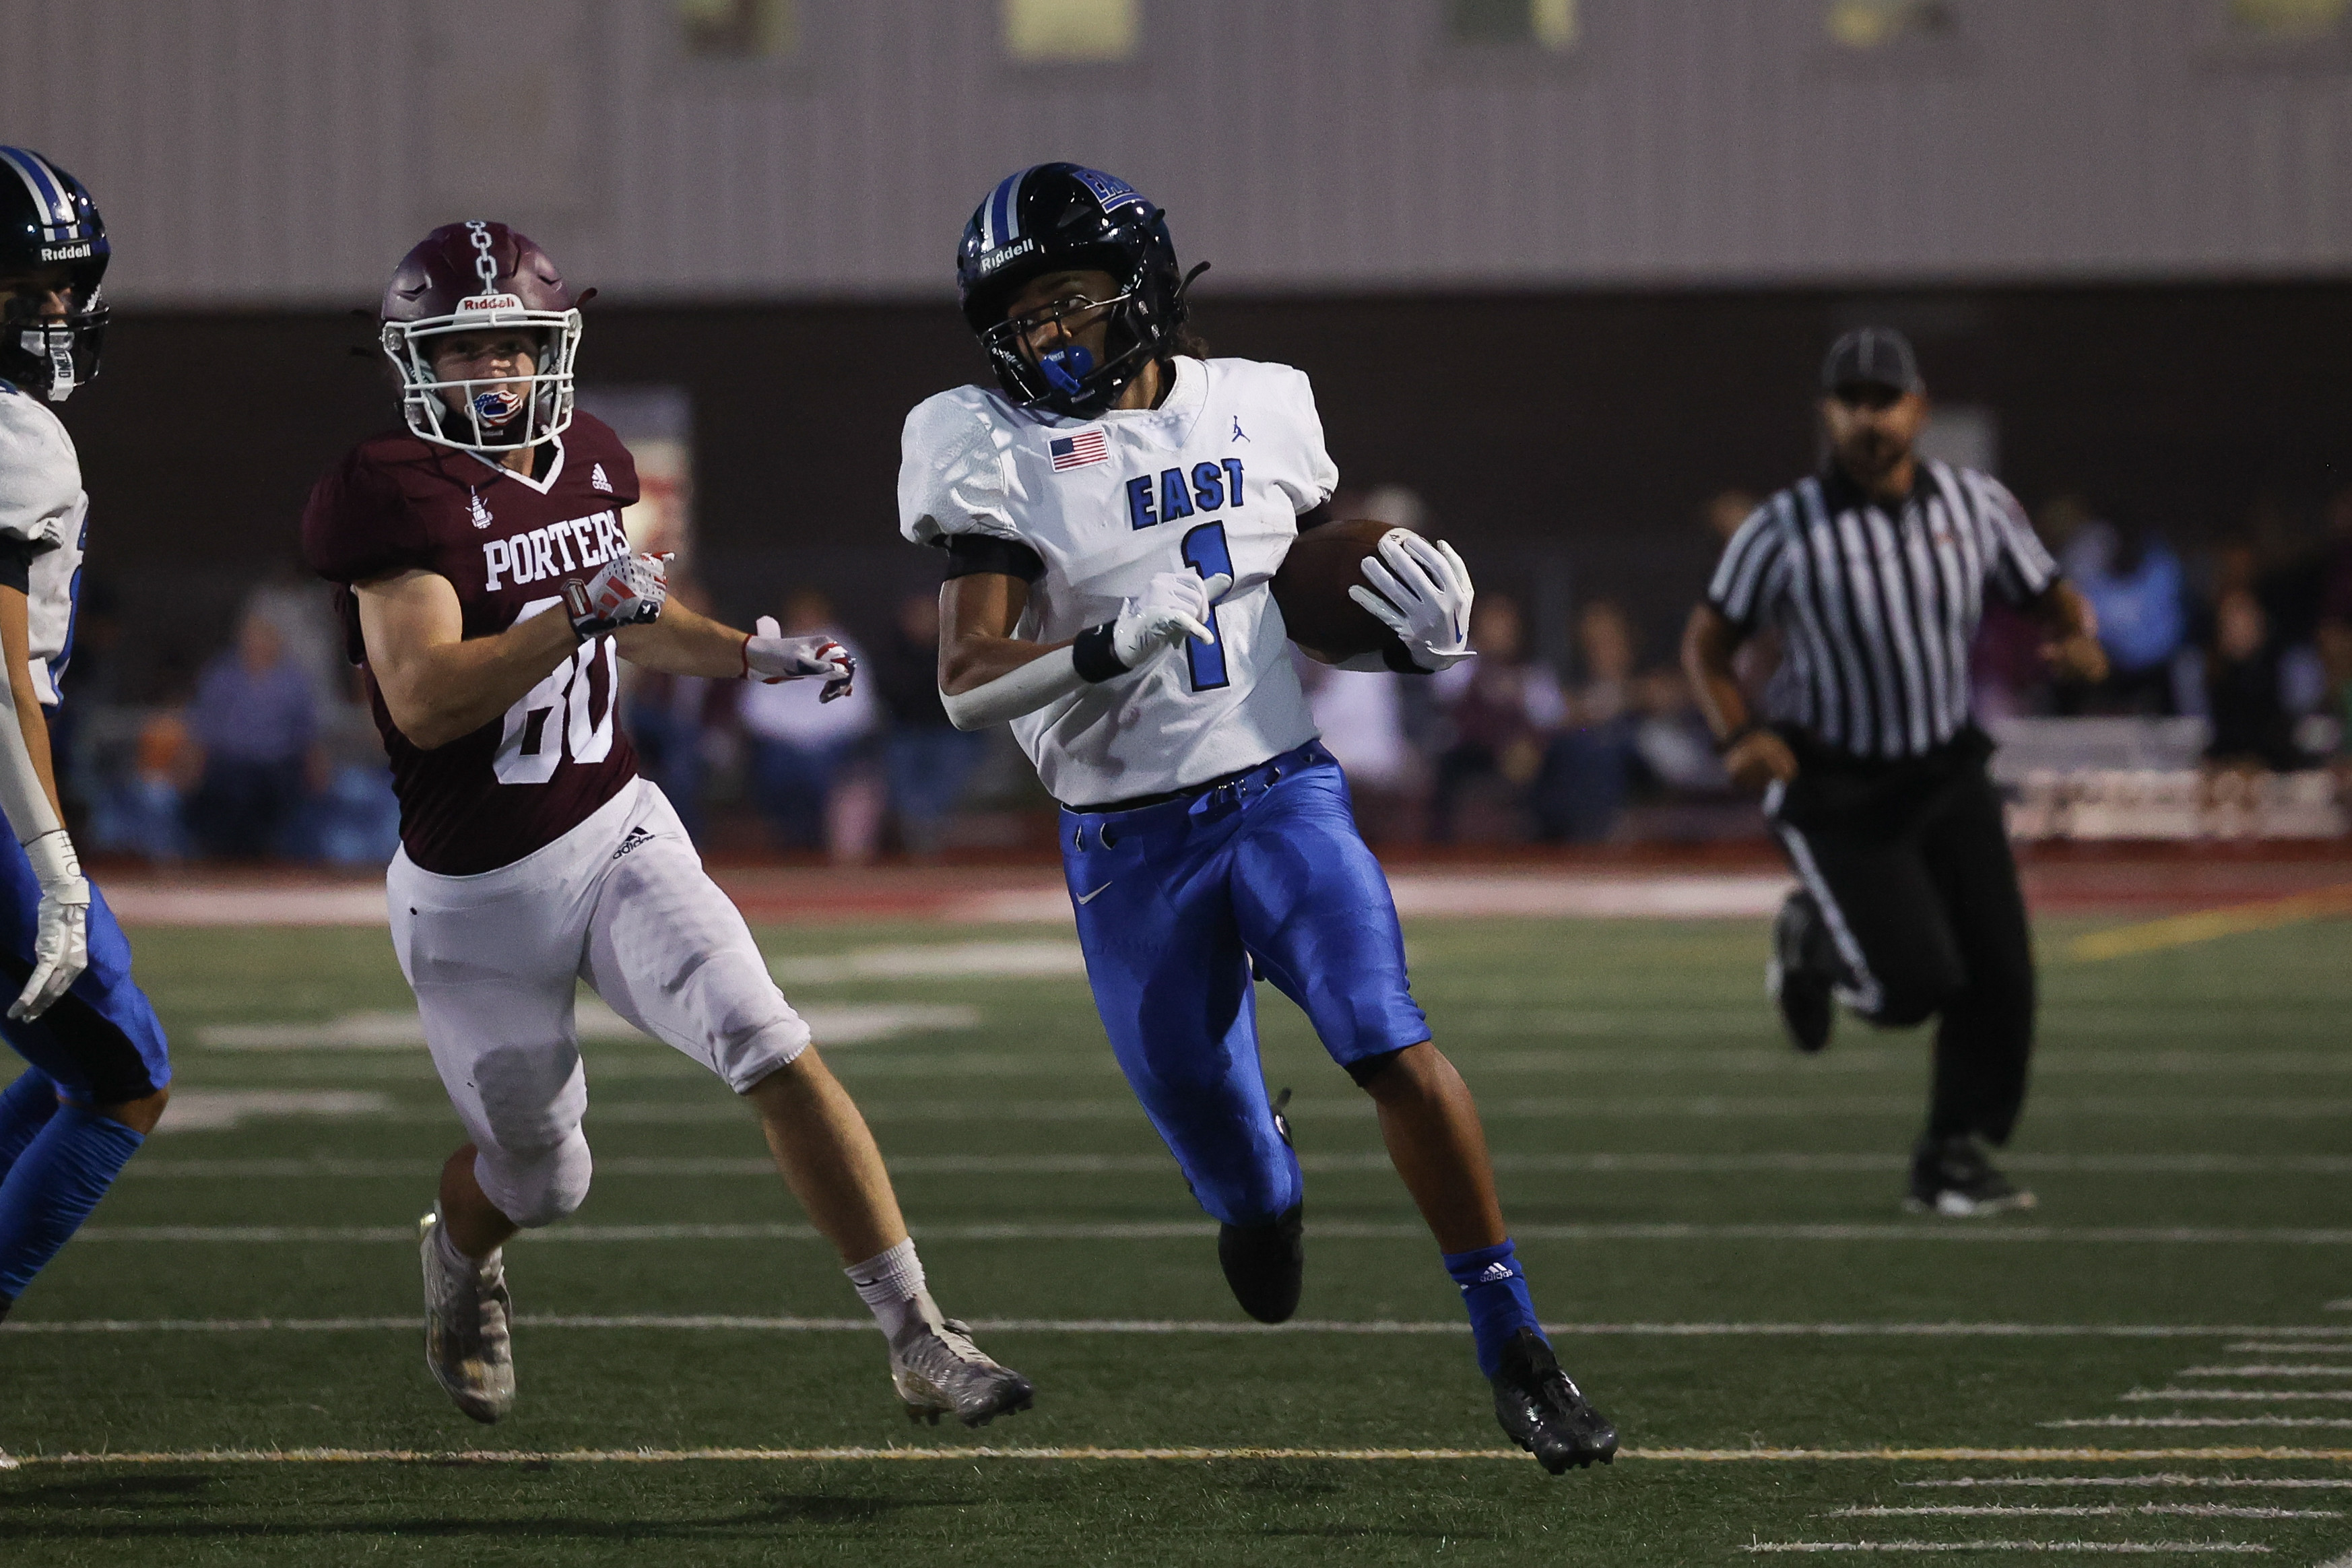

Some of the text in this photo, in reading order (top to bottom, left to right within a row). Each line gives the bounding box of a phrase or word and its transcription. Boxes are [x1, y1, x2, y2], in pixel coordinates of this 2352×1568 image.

[41, 243, 91, 261] Riddell
[981, 238, 1034, 272] Riddell
[1126, 458, 1244, 530] EAST
[483, 510, 631, 592] PORTERS
[1181, 519, 1234, 692] 1
[492, 595, 618, 785] 80
[612, 835, 656, 859] adid
[1480, 1269, 1513, 1282] adidas
